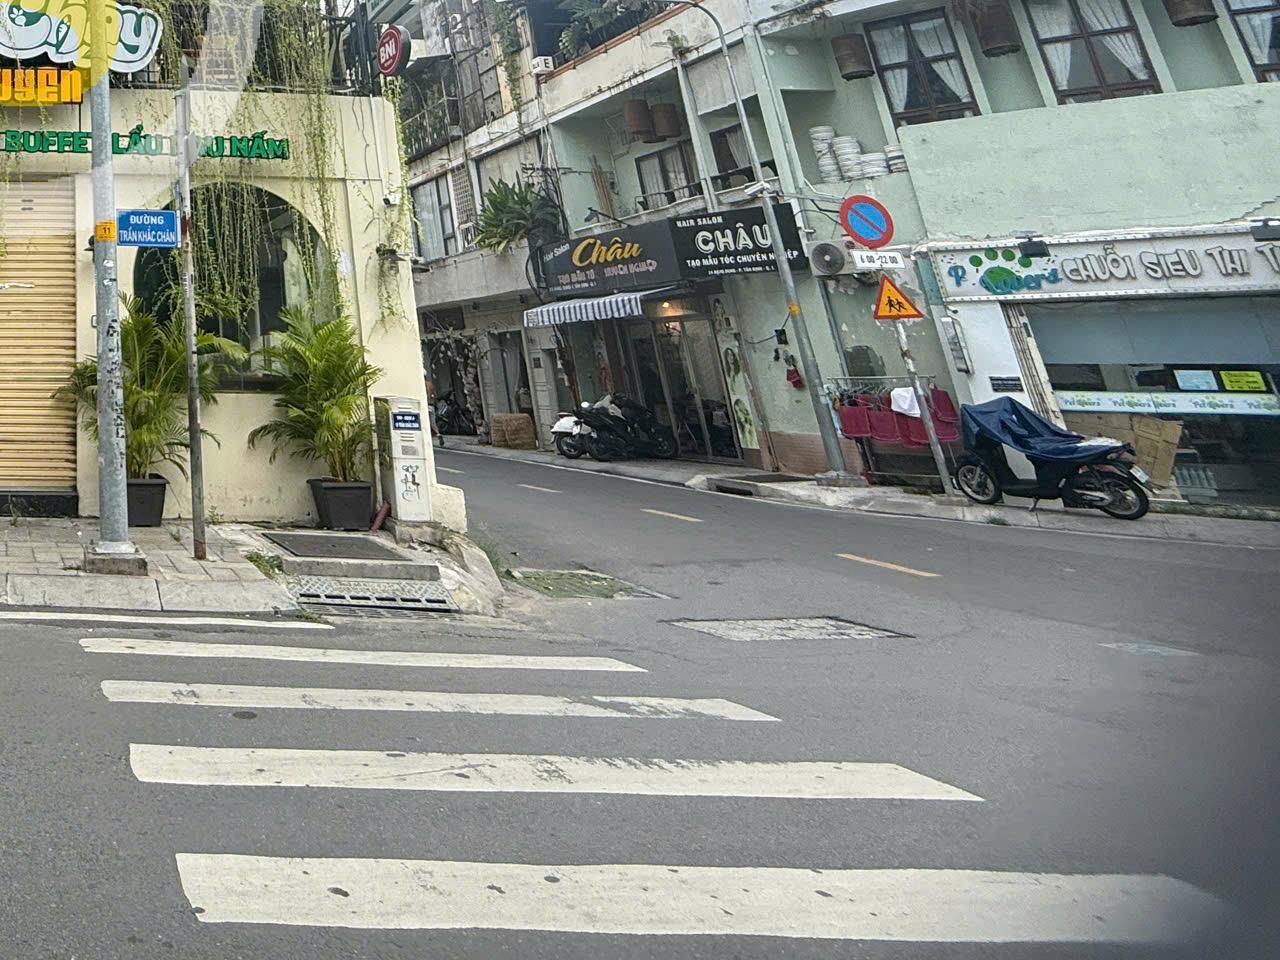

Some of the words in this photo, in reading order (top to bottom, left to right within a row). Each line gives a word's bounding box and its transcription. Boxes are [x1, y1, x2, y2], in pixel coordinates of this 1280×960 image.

[5, 129, 92, 154] BUFFE
[112, 124, 163, 156] LẨU
[230, 130, 289, 160] NẤM
[103, 226, 111, 234] 11
[129, 214, 165, 225] ĐƯỜNG
[697, 216, 723, 225] SALON
[695, 223, 772, 254] CHÂU
[571, 236, 643, 267] Châu
[720, 254, 735, 264] TÓC
[1061, 243, 1137, 282] CHUỖI
